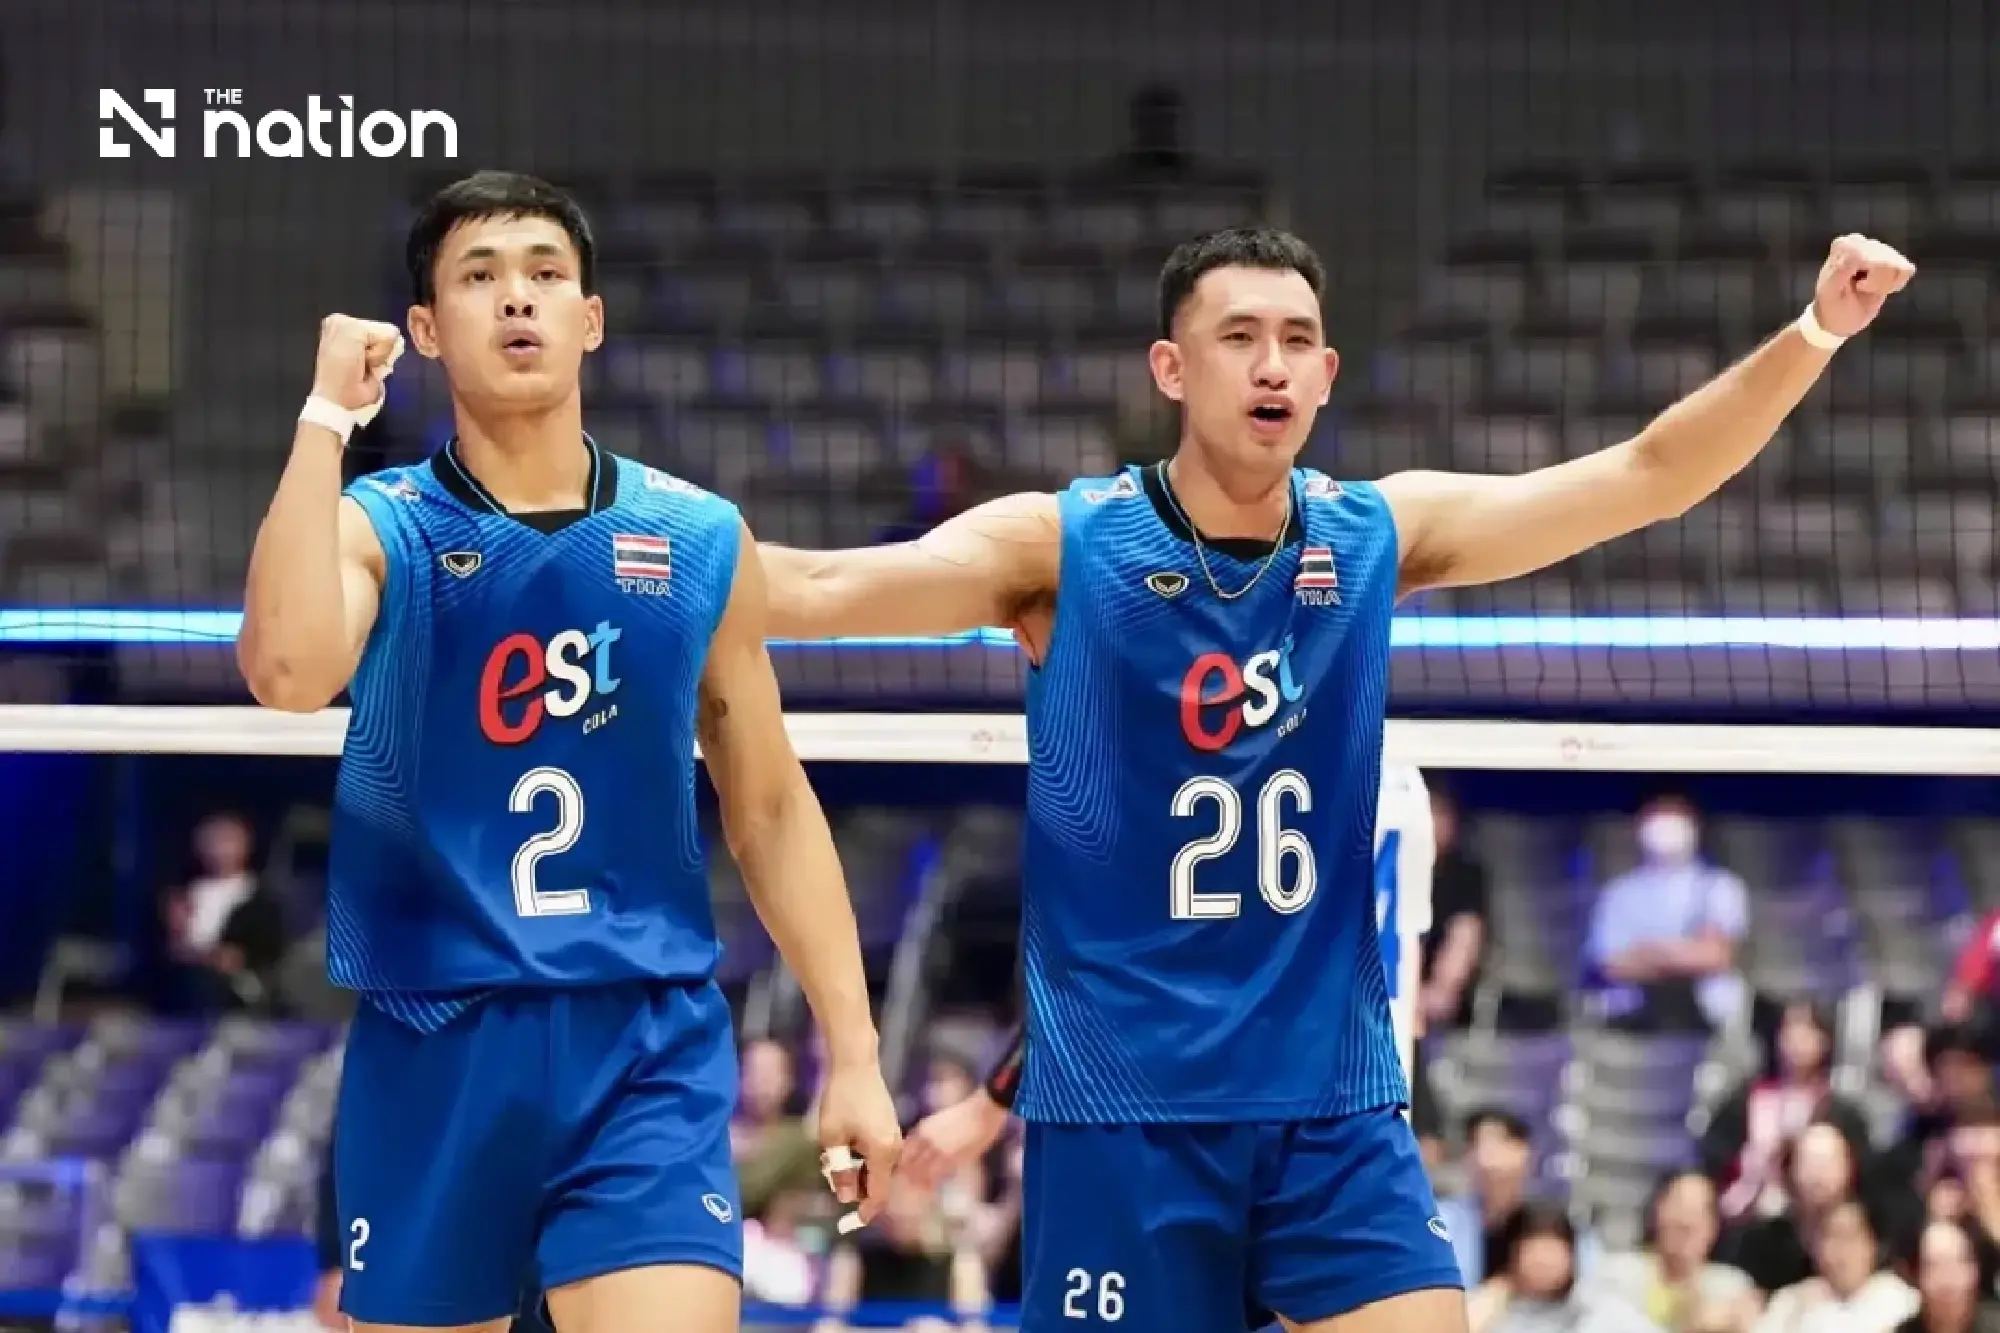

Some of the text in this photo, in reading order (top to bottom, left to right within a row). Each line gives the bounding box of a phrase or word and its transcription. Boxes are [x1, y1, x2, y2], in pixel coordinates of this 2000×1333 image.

[615, 578, 672, 596] THA
[1295, 589, 1342, 606] THA
[478, 620, 622, 744] est
[1180, 633, 1304, 752] est
[582, 704, 618, 735] COLA
[508, 765, 592, 917] 2
[1169, 768, 1318, 921] 26
[349, 1217, 370, 1271] 2
[1063, 1267, 1126, 1322] 26
